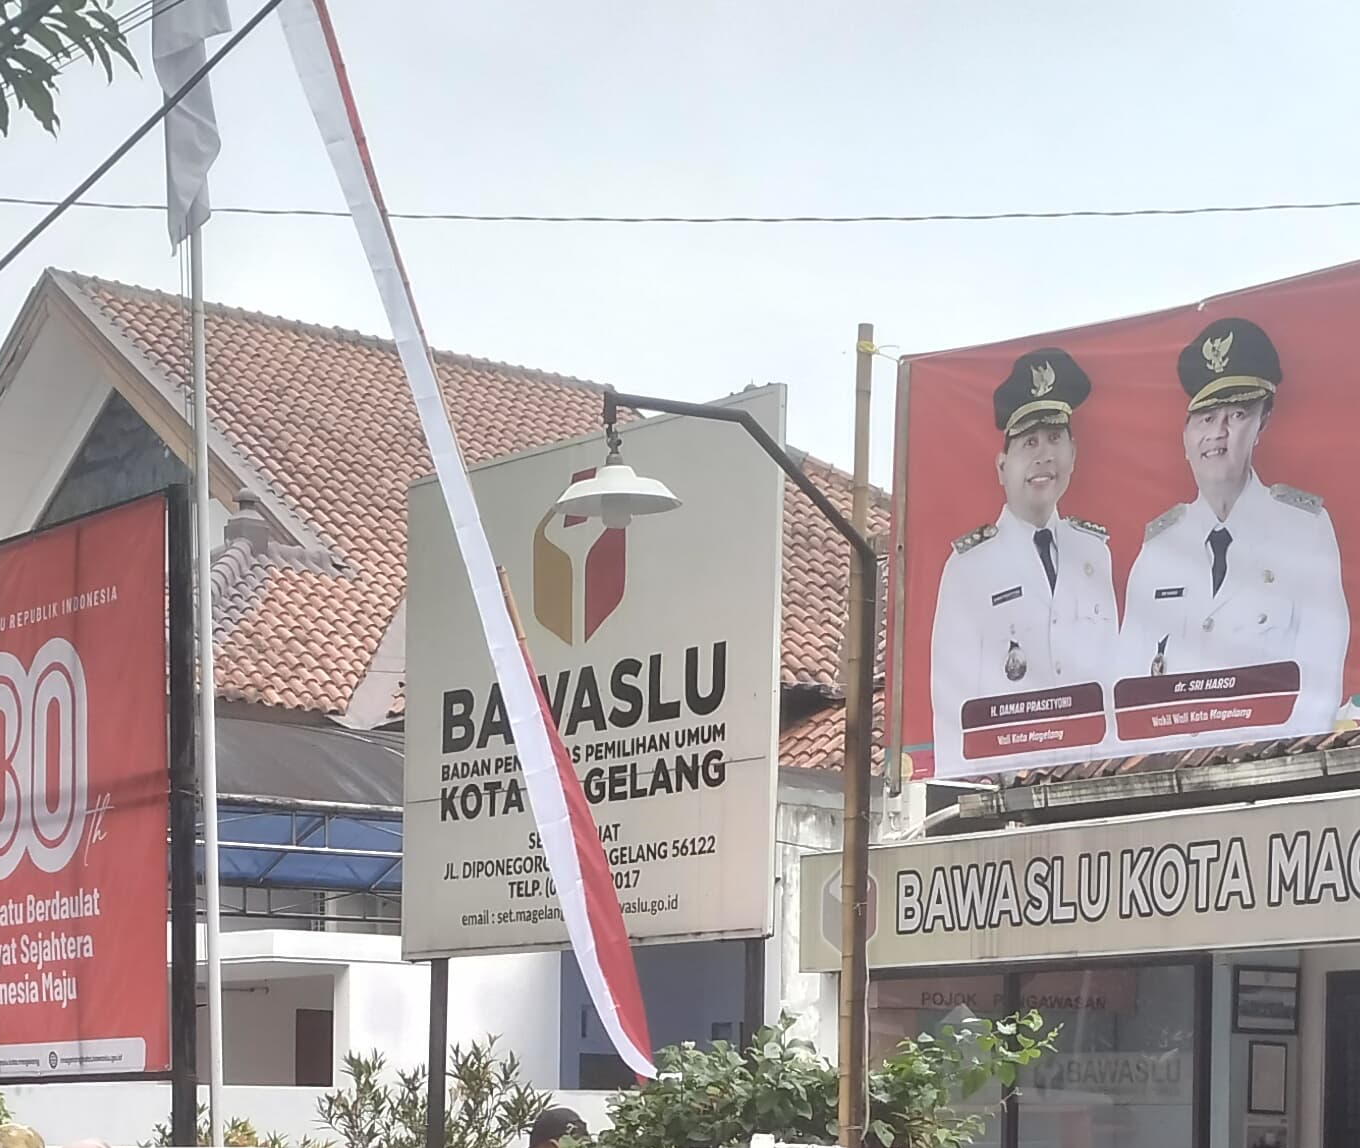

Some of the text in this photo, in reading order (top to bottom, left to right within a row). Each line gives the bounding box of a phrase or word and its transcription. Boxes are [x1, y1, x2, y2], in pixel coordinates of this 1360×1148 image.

[9, 602, 58, 630] REPUBLIK
[61, 585, 118, 616] INDONESIA
[1174, 677, 1236, 693] dr. SRI HARSO
[999, 702, 1025, 716] DAMAR
[1190, 710, 1208, 723] Kota
[441, 758, 490, 782] BADAN
[585, 731, 670, 762] PEMILIHAN
[674, 723, 726, 748] UMUM
[440, 749, 726, 822] KOTA GELANG
[443, 862, 460, 881] JL.
[606, 840, 669, 867] GELANG
[671, 835, 716, 857] 56122
[508, 880, 542, 899] TELP.
[896, 849, 1111, 935] BAWASLU
[1118, 837, 1256, 918] KOTA
[26, 887, 100, 923] Berdaulat
[461, 908, 489, 926] email
[20, 931, 93, 970] Sejahtera
[41, 970, 77, 1009] Maju
[922, 991, 977, 1007] POJOK
[1067, 1057, 1182, 1083] BAWASLU
